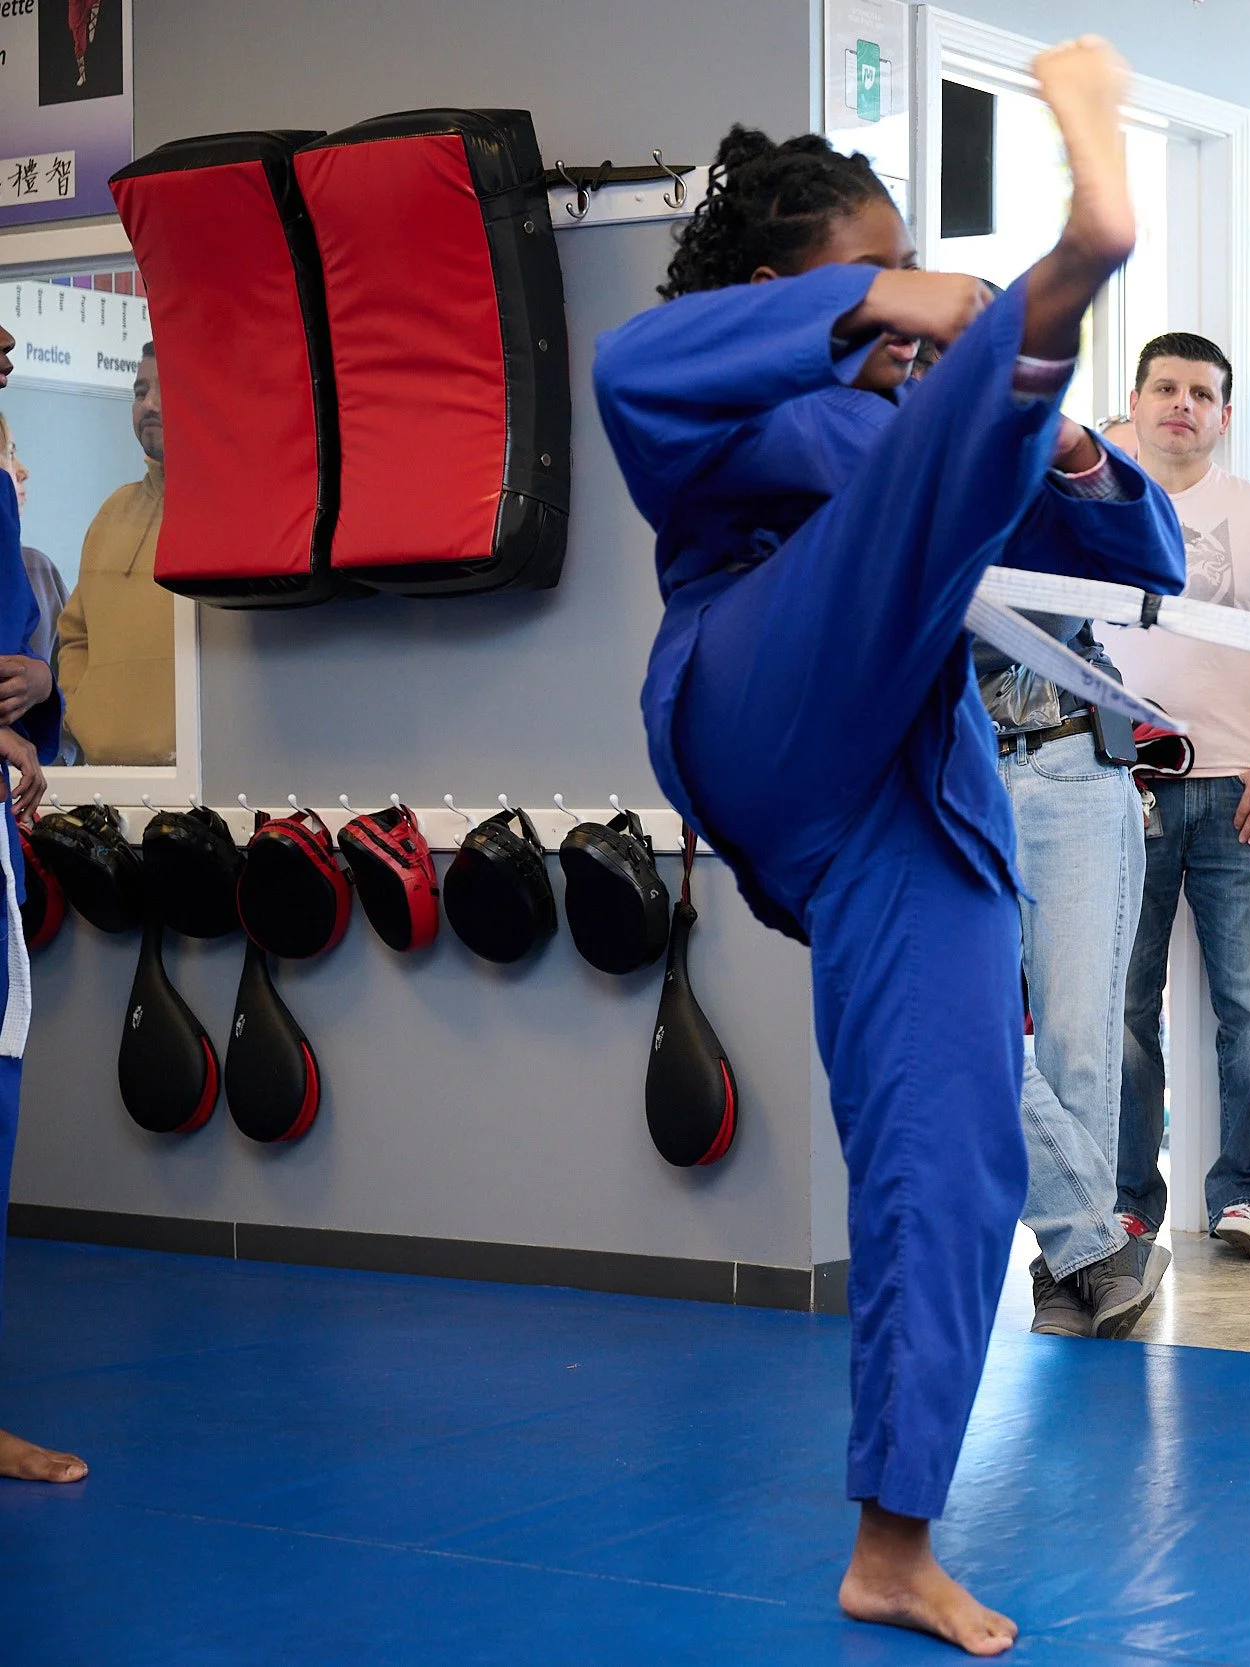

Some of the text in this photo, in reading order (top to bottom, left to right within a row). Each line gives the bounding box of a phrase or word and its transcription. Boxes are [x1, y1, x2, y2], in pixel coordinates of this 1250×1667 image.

[0, 0, 34, 17] ette
[0, 157, 72, 197] 禮智
[26, 342, 71, 364] Practice
